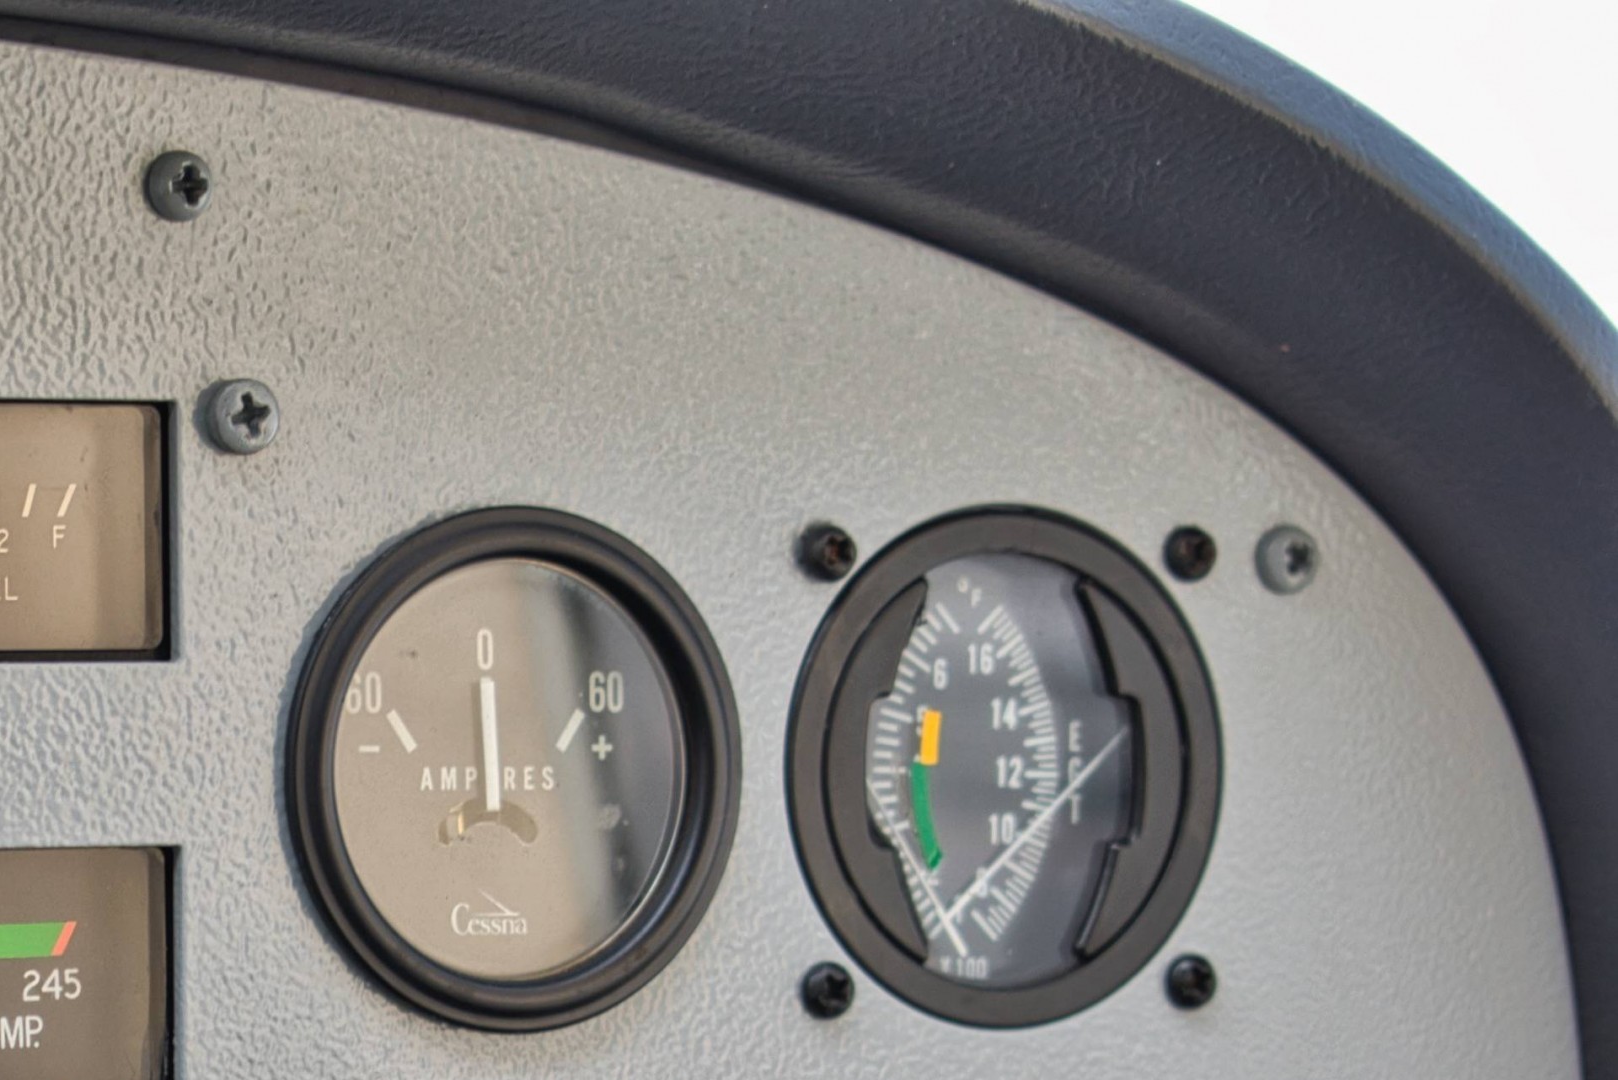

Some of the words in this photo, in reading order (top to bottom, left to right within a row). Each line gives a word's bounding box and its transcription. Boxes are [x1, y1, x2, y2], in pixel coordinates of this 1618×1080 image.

[53, 524, 67, 549] F
[476, 628, 494, 671] 0
[968, 643, 994, 675] 16
[933, 658, 949, 690] 6
[588, 671, 624, 713] 60
[991, 698, 1018, 731] 14
[420, 766, 555, 791] AMPRES
[997, 755, 1024, 789] 12
[989, 812, 1016, 845] 10
[451, 903, 528, 936] Cessna
[22, 968, 82, 1002] 245
